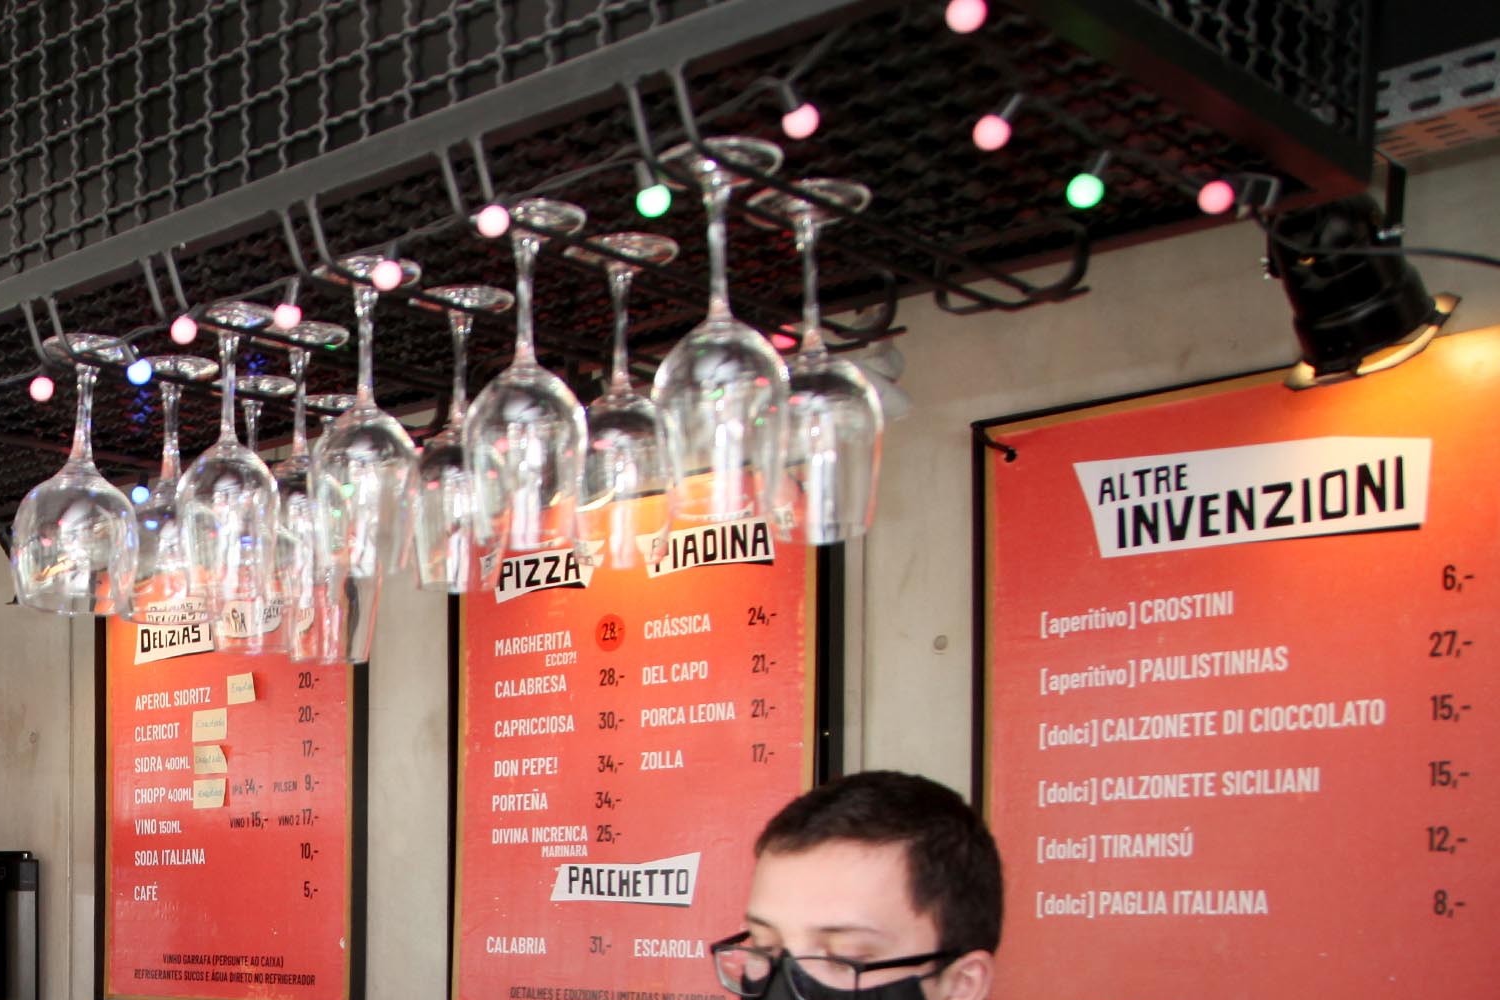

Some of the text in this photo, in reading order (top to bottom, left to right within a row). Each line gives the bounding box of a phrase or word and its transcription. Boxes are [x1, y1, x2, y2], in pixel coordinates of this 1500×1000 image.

[1097, 463, 1188, 507] ALTRE
[1116, 454, 1406, 550] INVENZIONI
[499, 550, 581, 592] PIZZA
[1040, 565, 1475, 639] [aperitivo] CROSTINI 6,-
[644, 606, 778, 640] CRÁSSICA 24,-
[140, 624, 201, 653] DELIZIAS
[494, 630, 572, 657] MARGHERITA
[545, 651, 577, 667] ECCO?!
[642, 653, 777, 687] DEL CAPO 21,-
[1040, 630, 1474, 695] [aperitivo] PAULISTINHAS 27,-
[135, 691, 172, 712] APEROL
[173, 686, 211, 707] SIDRITZ
[298, 672, 320, 689] 20,-
[494, 667, 626, 699] CALABRESA 28,-
[134, 722, 180, 743] CLERICOT
[298, 705, 320, 723] 20,-
[494, 710, 626, 738] CAPRICCIOSA 30,-
[640, 699, 777, 729] PORCA LEONA 21,-
[1039, 694, 1472, 750] [dolci] CALZONETE DI CIOCCOLATO 15,-
[134, 756, 163, 774] SIDRA
[165, 755, 190, 771] 400ML
[493, 754, 625, 778] DON PEPE! 34,-
[640, 743, 775, 771] ZOLLA 17,-
[134, 787, 166, 804] CHOPP
[167, 787, 194, 803] 400ML
[273, 781, 298, 792] PILSEN
[1038, 761, 1471, 807] [dolci] CALZONETE SICILIANI 15,-
[492, 788, 622, 812] PORTEÑA 34,-
[135, 818, 157, 836] VINO
[159, 820, 182, 834] 150ML
[492, 824, 622, 845] DIVINA INCRENCA 25,-
[134, 842, 319, 867] SODA ITALIANA 10,-
[541, 844, 588, 858] MARINARA
[1036, 826, 1469, 864] [dolci] TIRAMISÚ 12,-
[134, 881, 158, 901] CAFÉ
[567, 865, 690, 898] PACCHETTO
[1036, 889, 1466, 919] [dolci] PAGLIA ITALIANA 8,-
[486, 935, 613, 955] CALABRIA 31,-
[634, 938, 705, 960] ESCAROLA
[163, 954, 182, 965] VINHO
[183, 971, 204, 982] SUCOS
[510, 986, 553, 1000] DETALHES
[557, 987, 562, 1000] E
